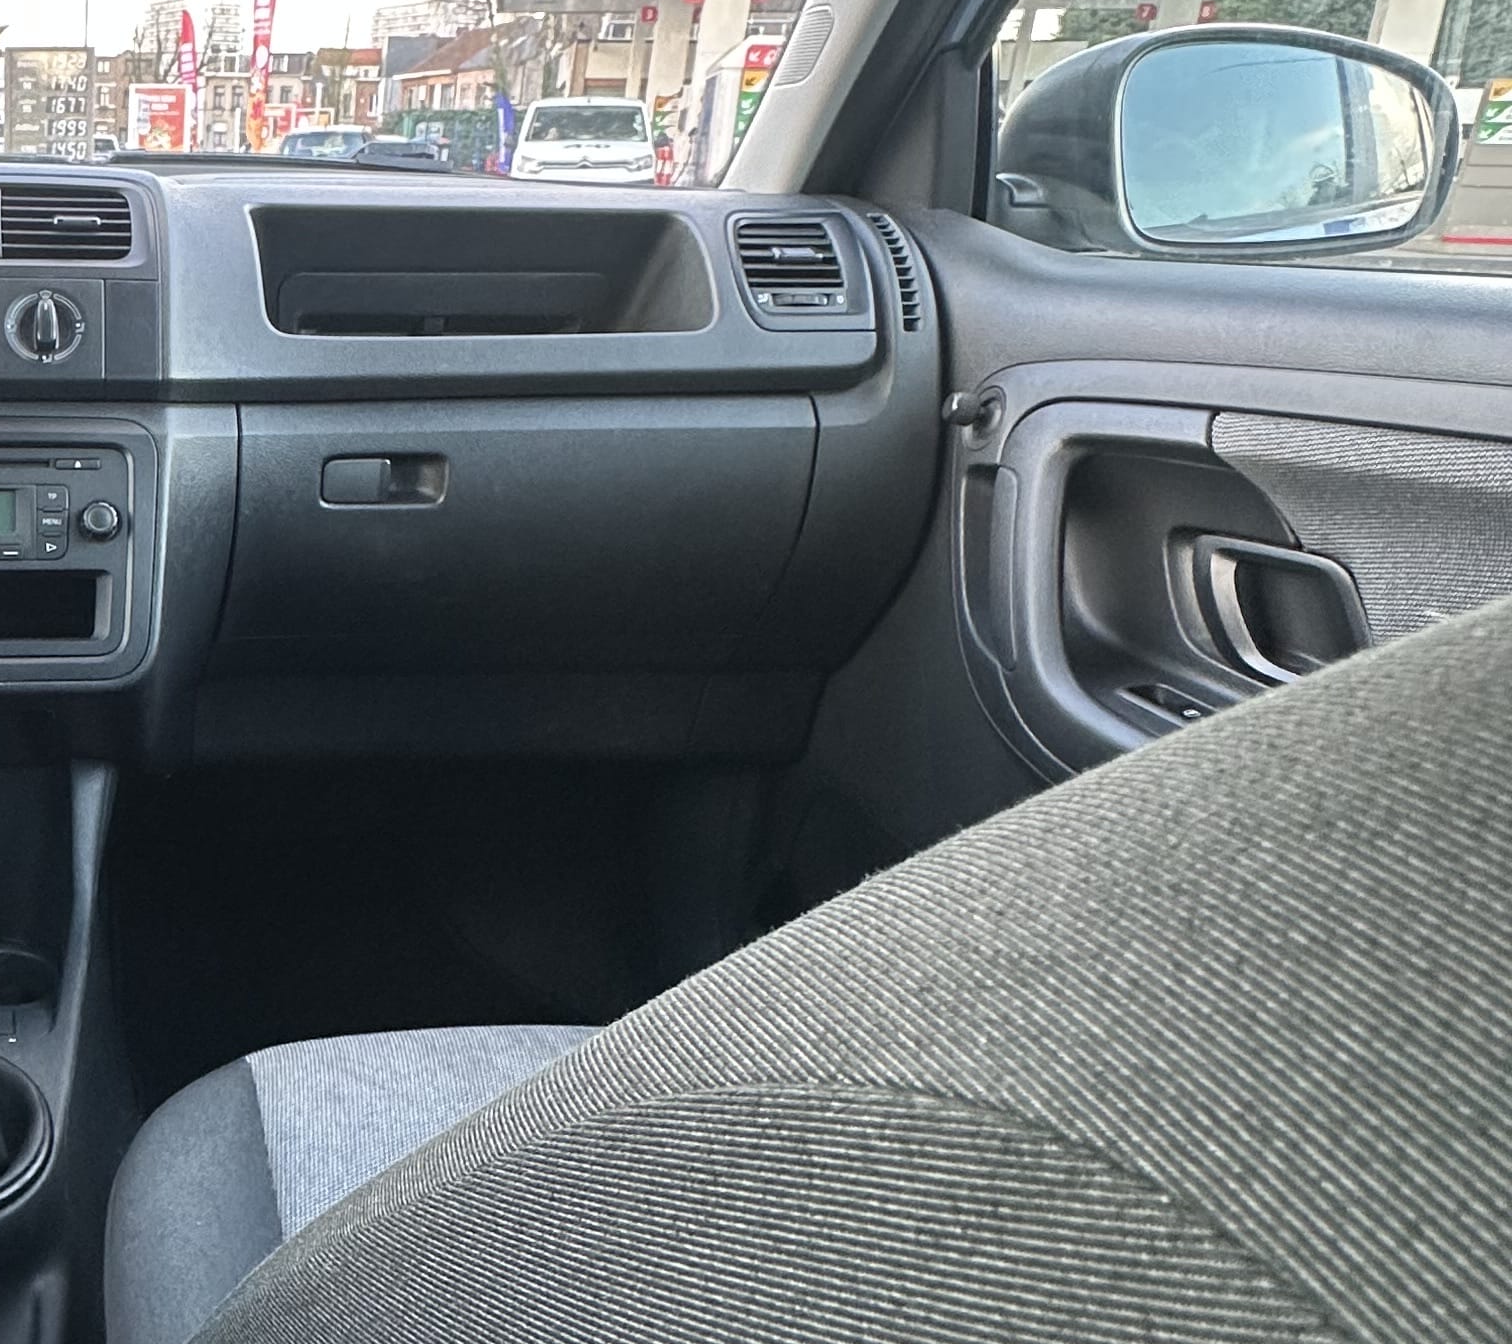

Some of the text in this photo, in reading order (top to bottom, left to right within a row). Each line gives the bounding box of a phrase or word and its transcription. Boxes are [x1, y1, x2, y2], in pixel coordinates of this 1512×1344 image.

[51, 96, 86, 114] 1677
[51, 119, 87, 136] 1999
[51, 141, 87, 161] 1450
